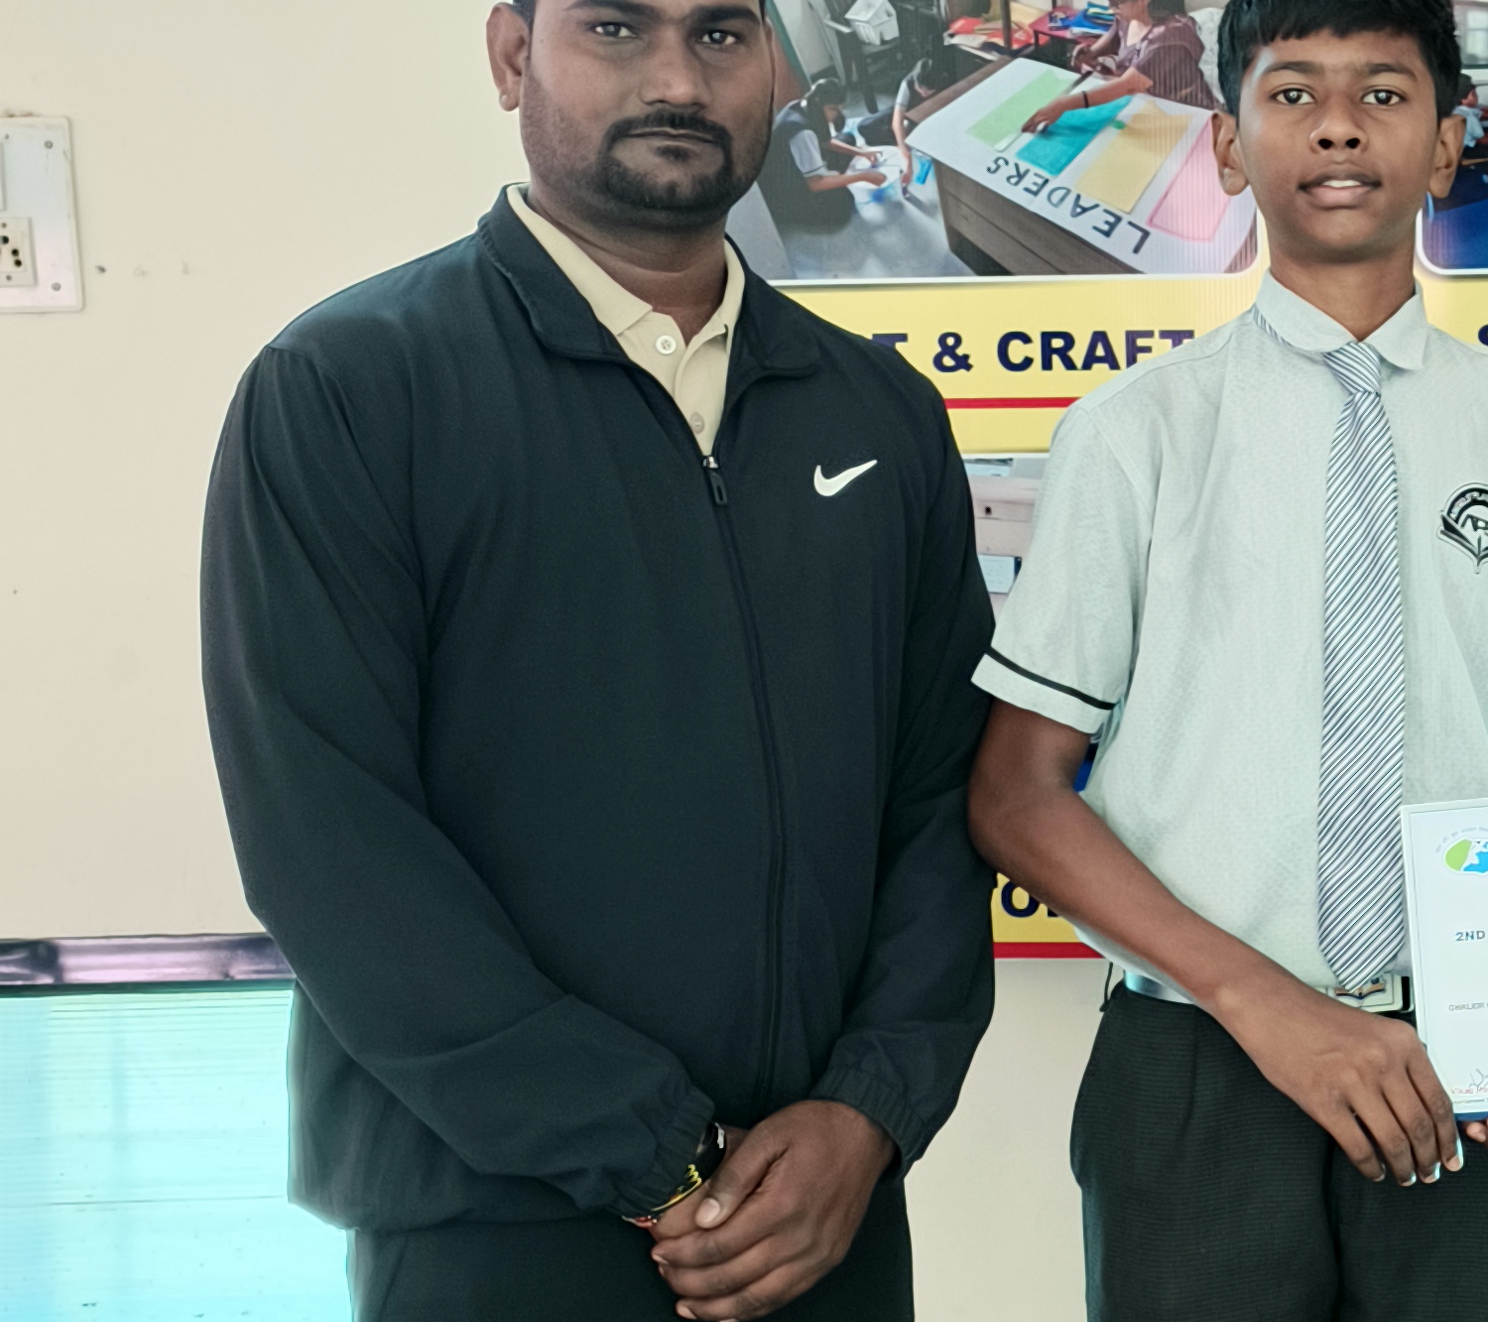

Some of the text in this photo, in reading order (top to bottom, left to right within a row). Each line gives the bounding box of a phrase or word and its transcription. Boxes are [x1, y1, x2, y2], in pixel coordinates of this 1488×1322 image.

[986, 156, 1151, 254] LEADERS
[932, 331, 974, 373] &
[1455, 930, 1486, 942] 2ND
